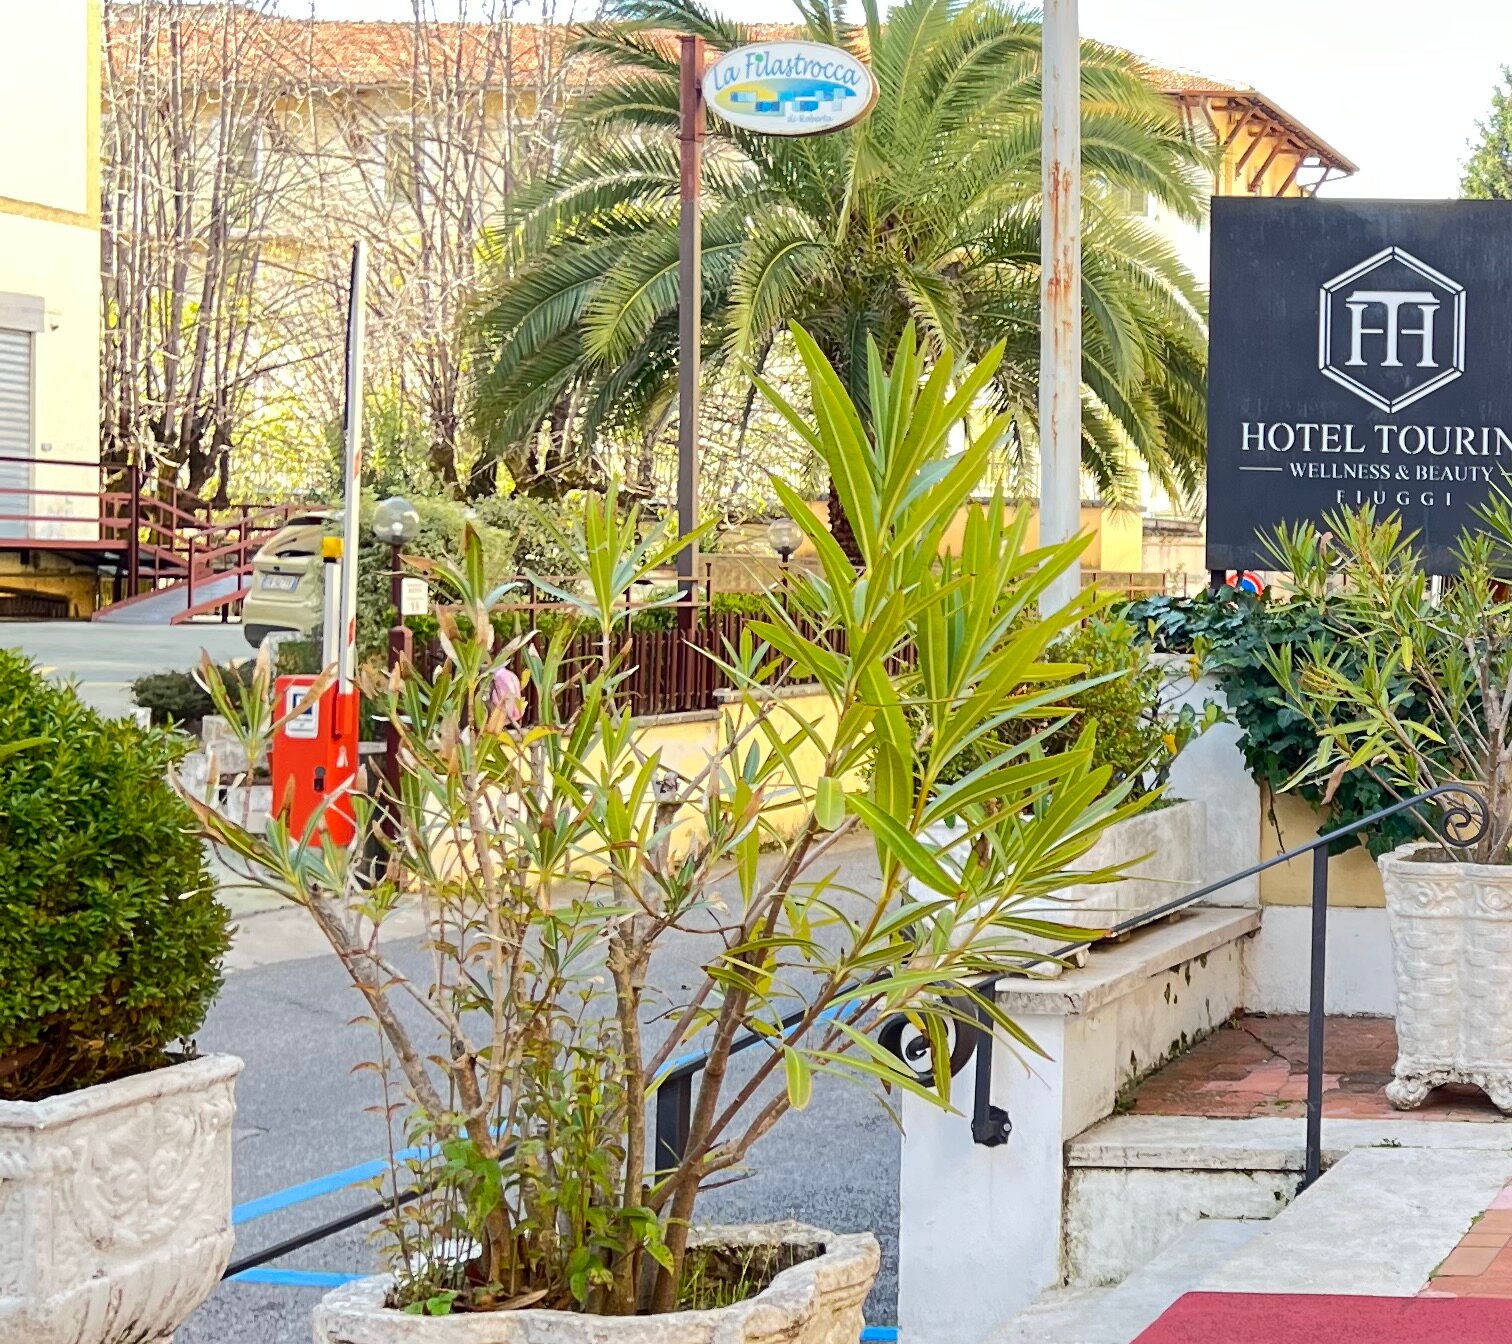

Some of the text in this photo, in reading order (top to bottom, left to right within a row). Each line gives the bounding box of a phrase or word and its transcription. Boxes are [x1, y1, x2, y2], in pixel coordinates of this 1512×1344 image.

[714, 50, 861, 90] La Filastrocca
[1241, 422, 1366, 454] HOTEL
[1290, 463, 1494, 482] WELLNESS & BEAUTY
[1336, 489, 1452, 507] FIUGGI
